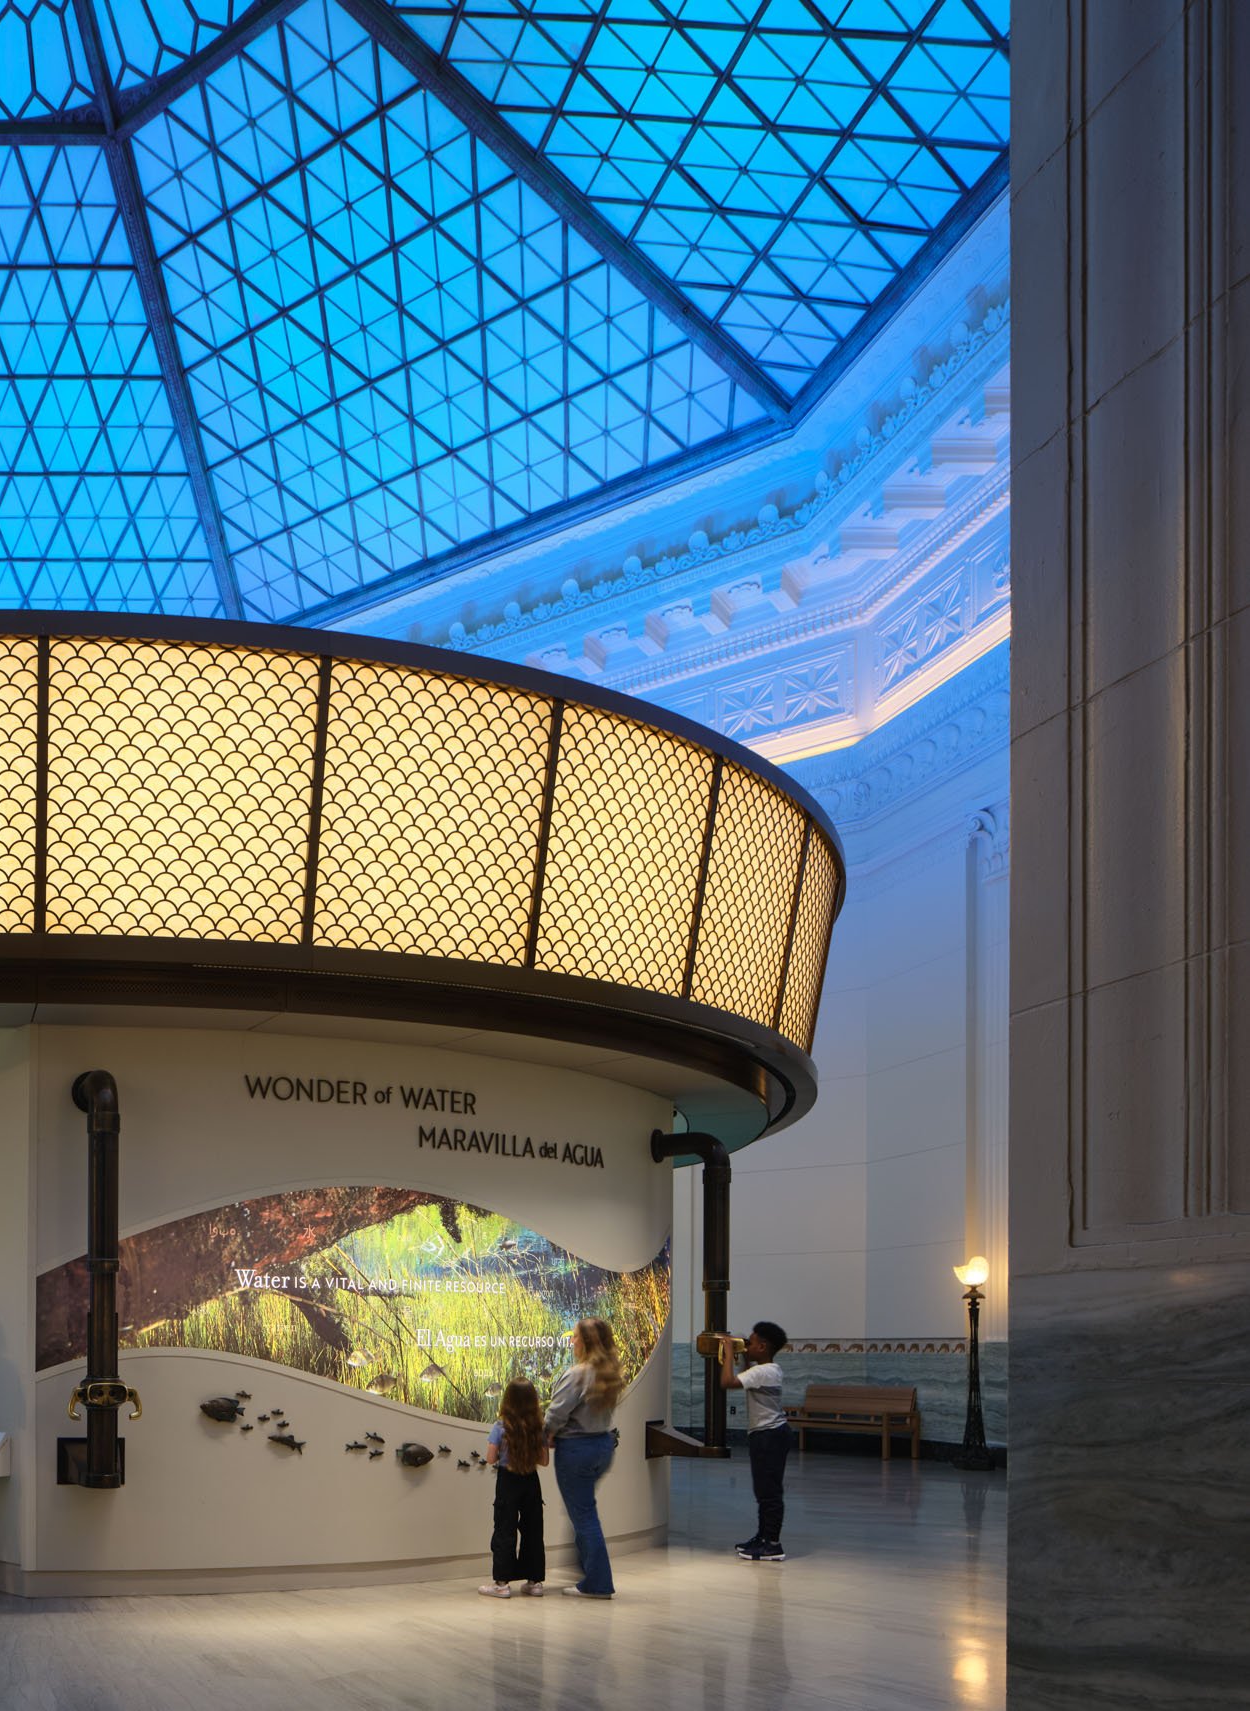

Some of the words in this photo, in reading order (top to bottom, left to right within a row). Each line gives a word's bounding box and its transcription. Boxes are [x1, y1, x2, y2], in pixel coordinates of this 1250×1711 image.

[245, 1074, 367, 1105] WONDER
[374, 1086, 392, 1104] of
[400, 1085, 477, 1115] WATER
[418, 1125, 535, 1158] MARAVILLA
[539, 1142, 558, 1160] del
[562, 1142, 605, 1168] AGUA
[303, 1223, 316, 1239] 水
[234, 1268, 290, 1289] Water
[294, 1276, 307, 1289] IS
[311, 1277, 321, 1289] A
[326, 1277, 364, 1291] VITAL
[368, 1279, 397, 1291] AND
[402, 1279, 442, 1292] FINITE
[445, 1280, 506, 1294] RESOURCE
[416, 1329, 431, 1348] El
[435, 1329, 471, 1353] Agua
[474, 1335, 487, 1347] ES
[490, 1335, 506, 1347] UN
[509, 1335, 554, 1348] RECURSO
